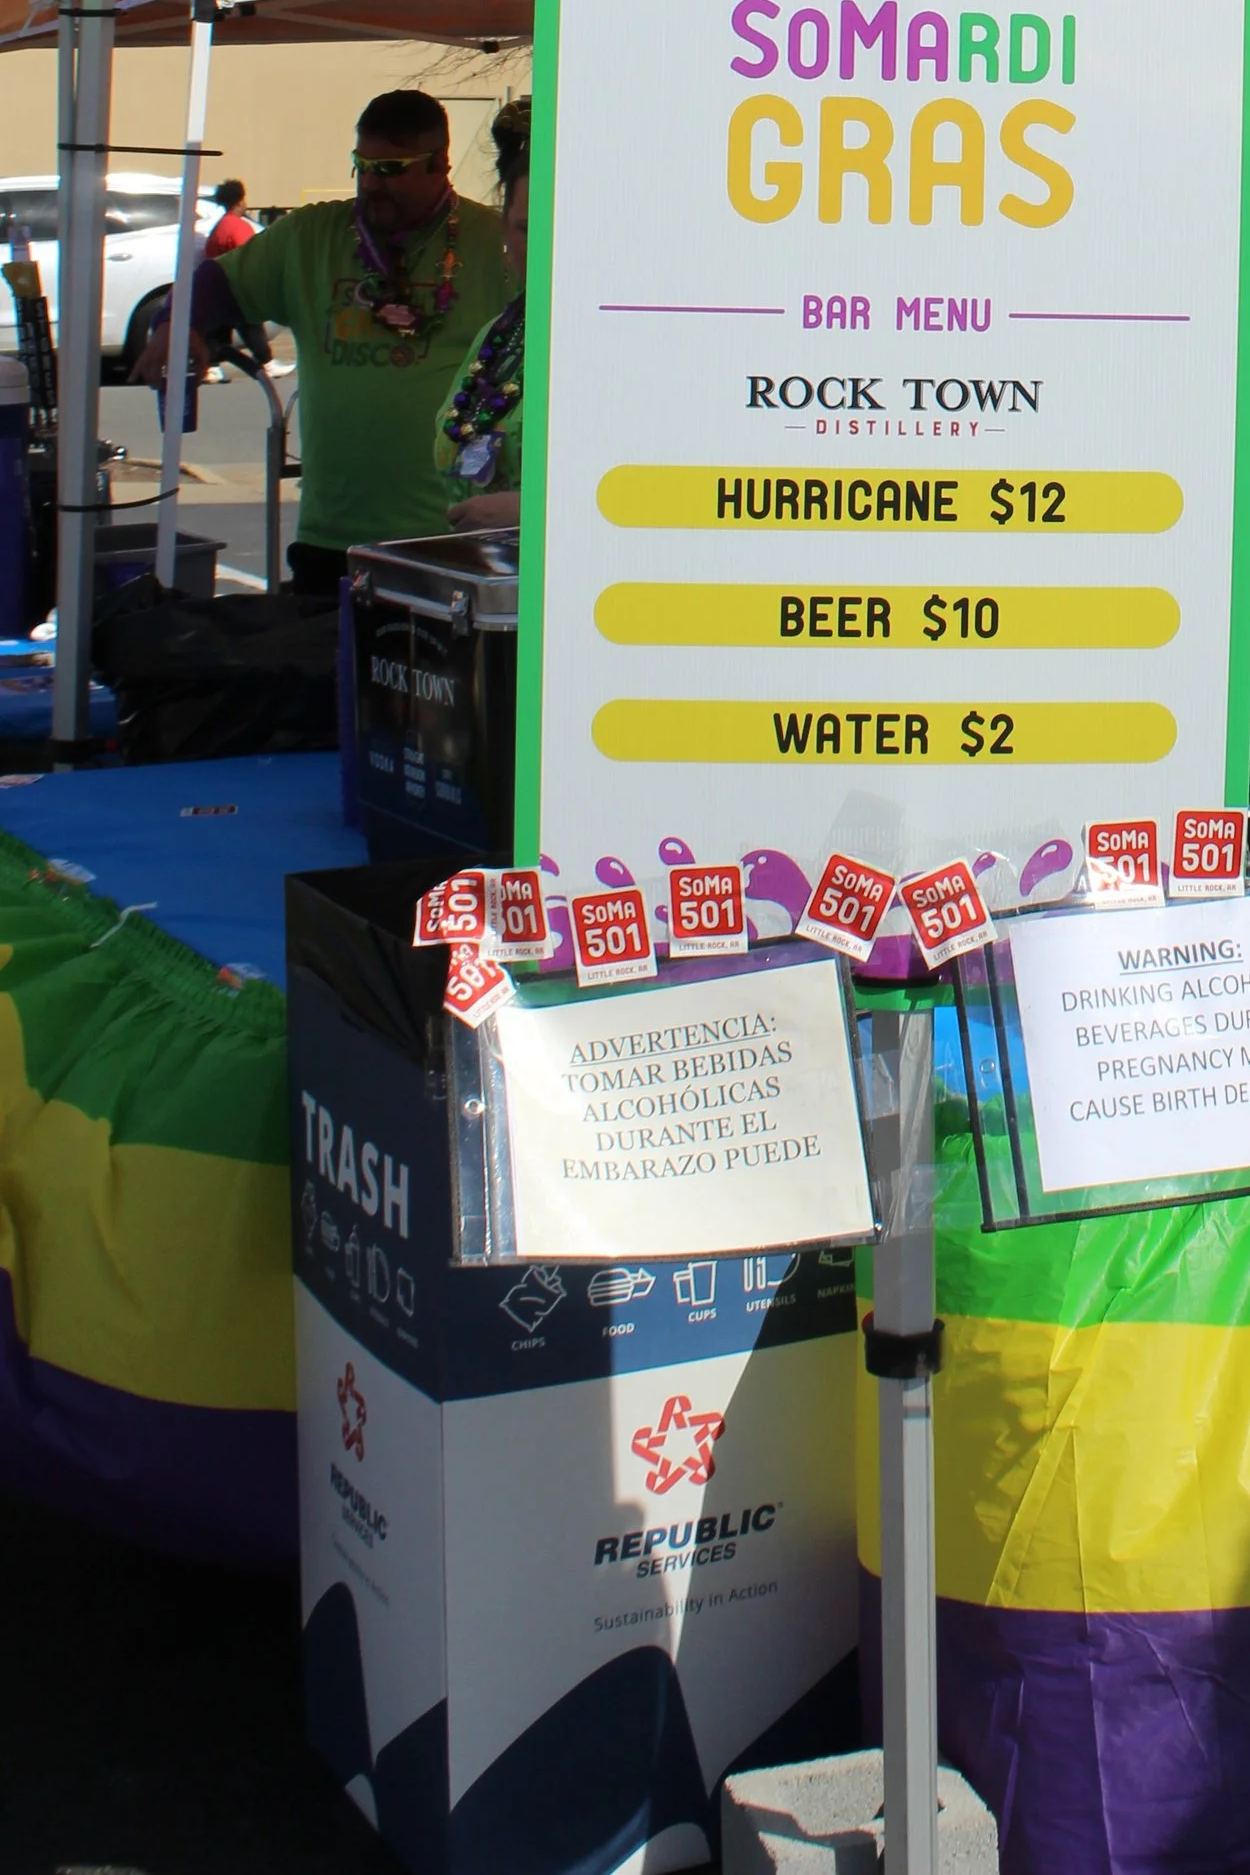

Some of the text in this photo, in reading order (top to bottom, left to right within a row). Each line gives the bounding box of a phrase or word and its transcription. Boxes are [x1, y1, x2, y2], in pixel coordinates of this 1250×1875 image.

[727, 93, 1077, 229] GRAS
[802, 295, 992, 332] BAR MENU
[746, 375, 1044, 413] ROCK TOWN
[815, 420, 978, 436] DISTILLERY
[717, 477, 1066, 525] HURRICANE $12
[780, 594, 1000, 641] BEER $10
[370, 655, 456, 707] ROCK TOWN
[773, 710, 1014, 757] WATER $2
[1097, 829, 1149, 852] SoMA
[1184, 818, 1235, 839] SoMA
[1182, 843, 1234, 872] 501
[678, 875, 733, 897] SoMA
[831, 864, 884, 902] SoMA
[912, 875, 966, 909] SoMA
[448, 878, 478, 931] 501
[581, 899, 636, 925] SoMA
[680, 898, 735, 931] 501
[819, 886, 876, 933] 501
[920, 893, 978, 940] 501
[585, 922, 642, 958] 501
[1118, 939, 1242, 973] WARNING:
[1061, 982, 1173, 1012] DRINKING
[570, 1013, 777, 1065] ADVERTENCIA:
[1076, 1014, 1207, 1047] BEVERAGES
[561, 1040, 793, 1094] TOMAR BEBIDAS
[1098, 1047, 1233, 1081] PREGNANCY
[582, 1076, 781, 1123] ALCOHÓLICAS
[1070, 1094, 1145, 1121] CAUSE
[1152, 1086, 1216, 1113] BIRTH
[597, 1110, 777, 1152] DURANTE EL
[301, 1089, 409, 1240] TRASH
[562, 1135, 822, 1181] EMBARAZO PUEDE
[688, 1308, 717, 1324] CUPS
[745, 1293, 797, 1313] UTENSILS
[511, 1336, 546, 1351] CHIPS
[602, 1322, 635, 1338] FOOD
[594, 1503, 777, 1566] REPUBLIC
[636, 1542, 737, 1579] SERVICES
[594, 1580, 778, 1633] Sustainability in Action
